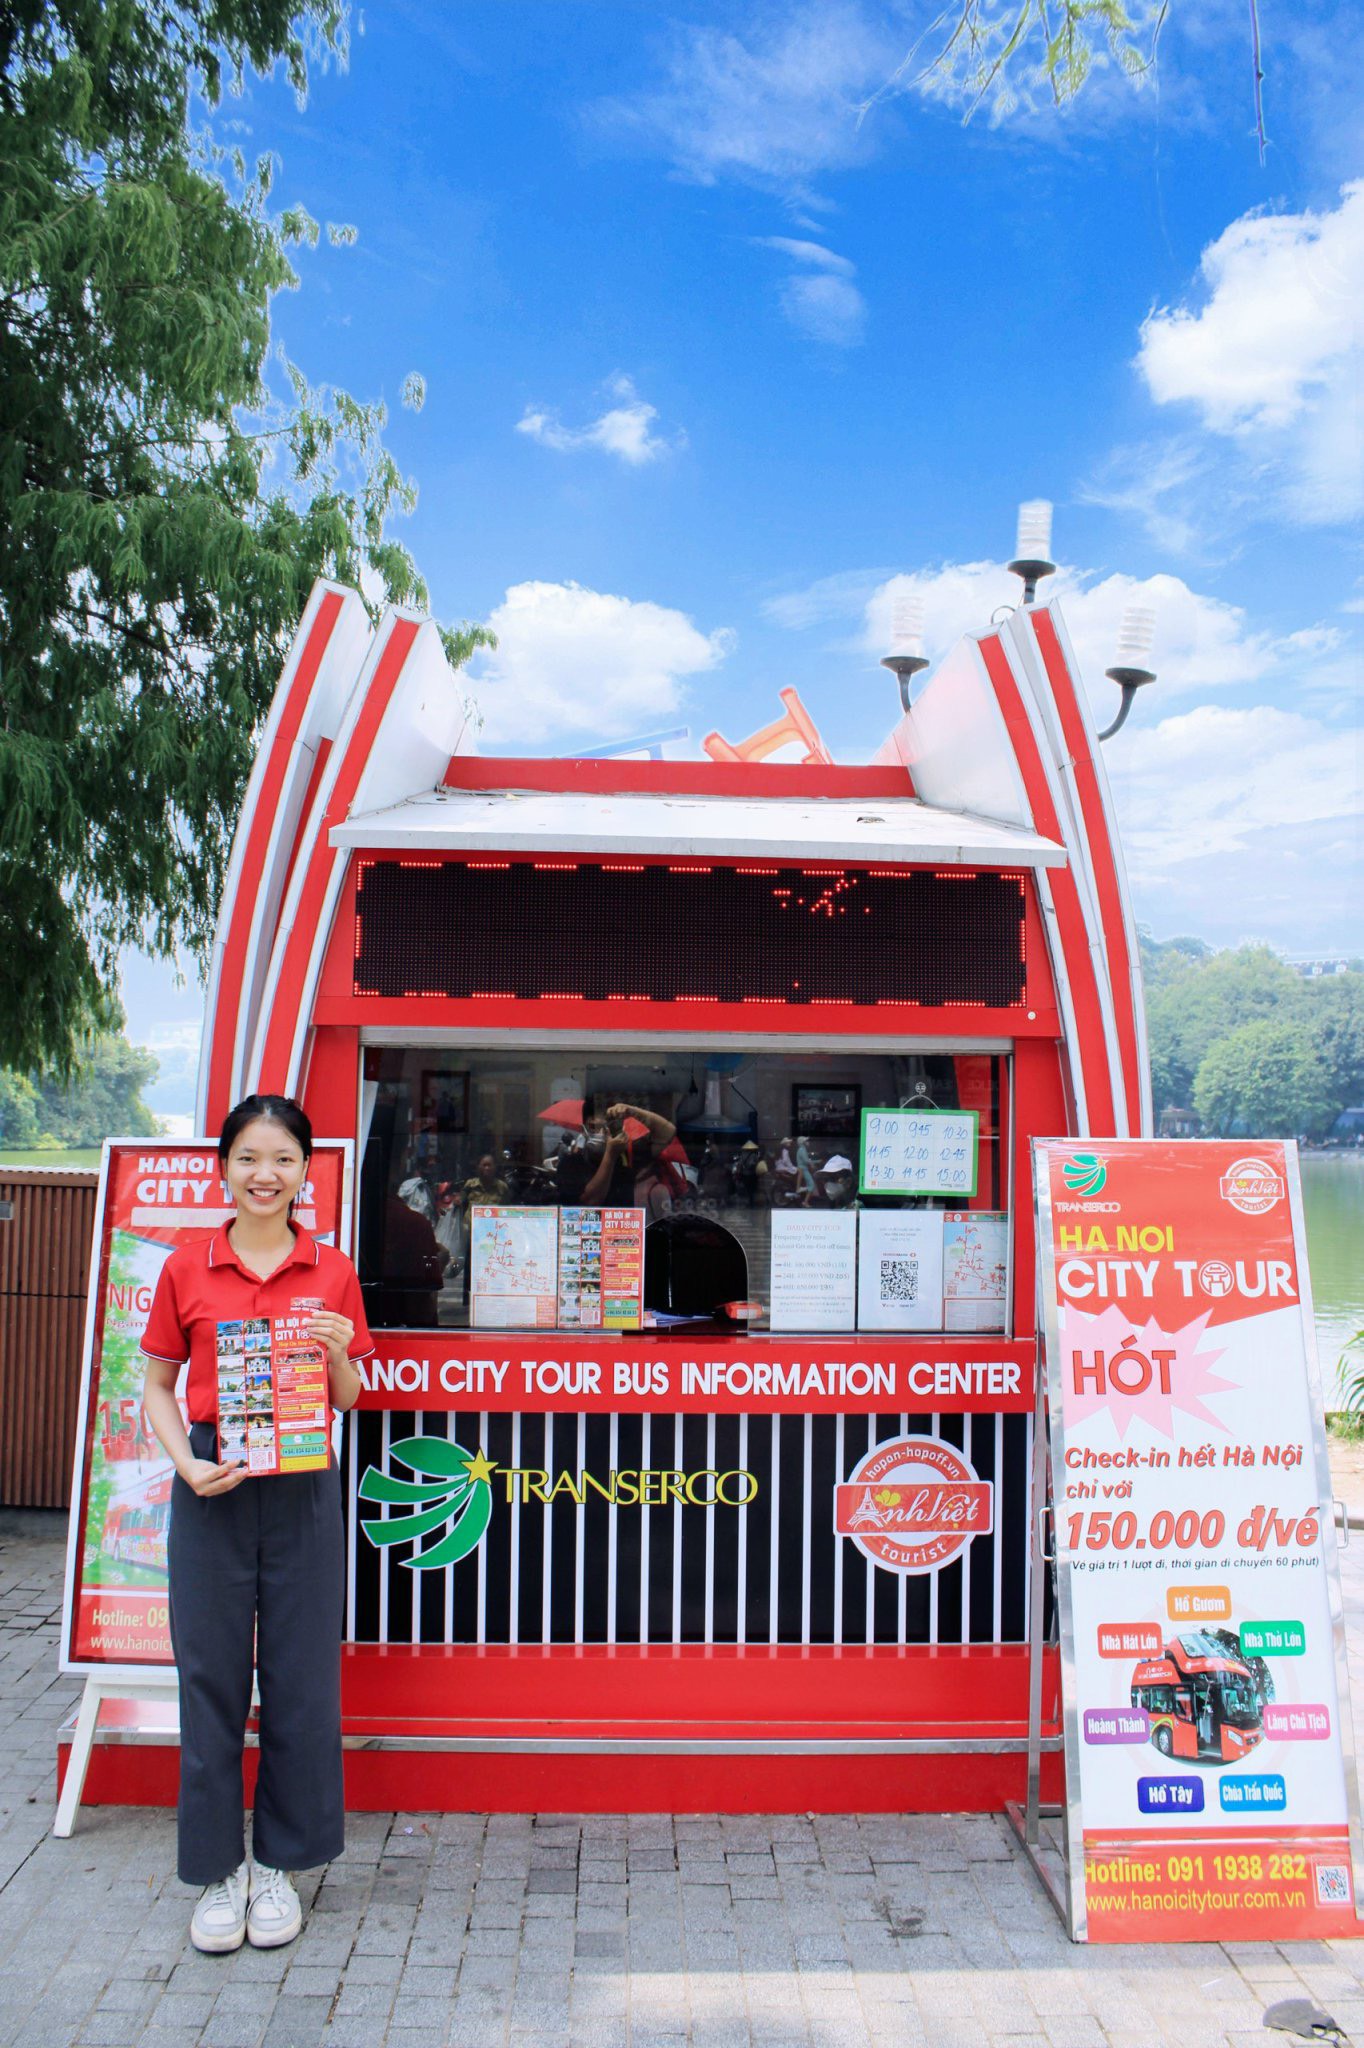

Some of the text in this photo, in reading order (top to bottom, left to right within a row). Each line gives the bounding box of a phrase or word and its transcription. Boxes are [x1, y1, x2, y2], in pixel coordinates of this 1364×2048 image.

[138, 1157, 214, 1174] HANOI
[137, 1179, 315, 1205] CITY TR
[605, 1220, 619, 1229] CITY
[1060, 1225, 1175, 1253] HA NOI
[1058, 1260, 1297, 1298] CITY TOUR
[109, 1283, 152, 1312] NIG
[275, 1330, 294, 1341] CITY
[1073, 1335, 1176, 1395] HÓT
[356, 1359, 1021, 1396] ANOI CITY TOUR BUS INFORMATION CENTER
[865, 1446, 961, 1480] hopon-hopoff.vn
[1065, 1443, 1303, 1471] Check-in hết Hà Nội
[495, 1468, 759, 1506] TRANSERCO
[1102, 1480, 1133, 1498] với
[1067, 1505, 1319, 1552] 150.000 đ/vé
[881, 1542, 947, 1563] tourist
[1123, 1559, 1128, 1569] 1
[1194, 1558, 1217, 1571] gian
[1276, 1557, 1289, 1567] 60
[1174, 1595, 1190, 1612] Hồ
[93, 1606, 169, 1628] Hotline: 09
[91, 1633, 174, 1652] www.hanoic
[1102, 1632, 1158, 1651] Nhà Hát Lớn
[1244, 1631, 1263, 1649] Nhà
[1087, 1716, 1146, 1736] Hoàng Thành
[1267, 1712, 1289, 1732] Lăng
[1307, 1712, 1327, 1733] Tịch
[1149, 1784, 1193, 1805] Hồ Tây
[1262, 1781, 1284, 1803] Quốc
[1085, 1854, 1308, 1884] Hotline: 091 1938 282
[1086, 1889, 1306, 1914] www.hanoicitytour.com.vn
